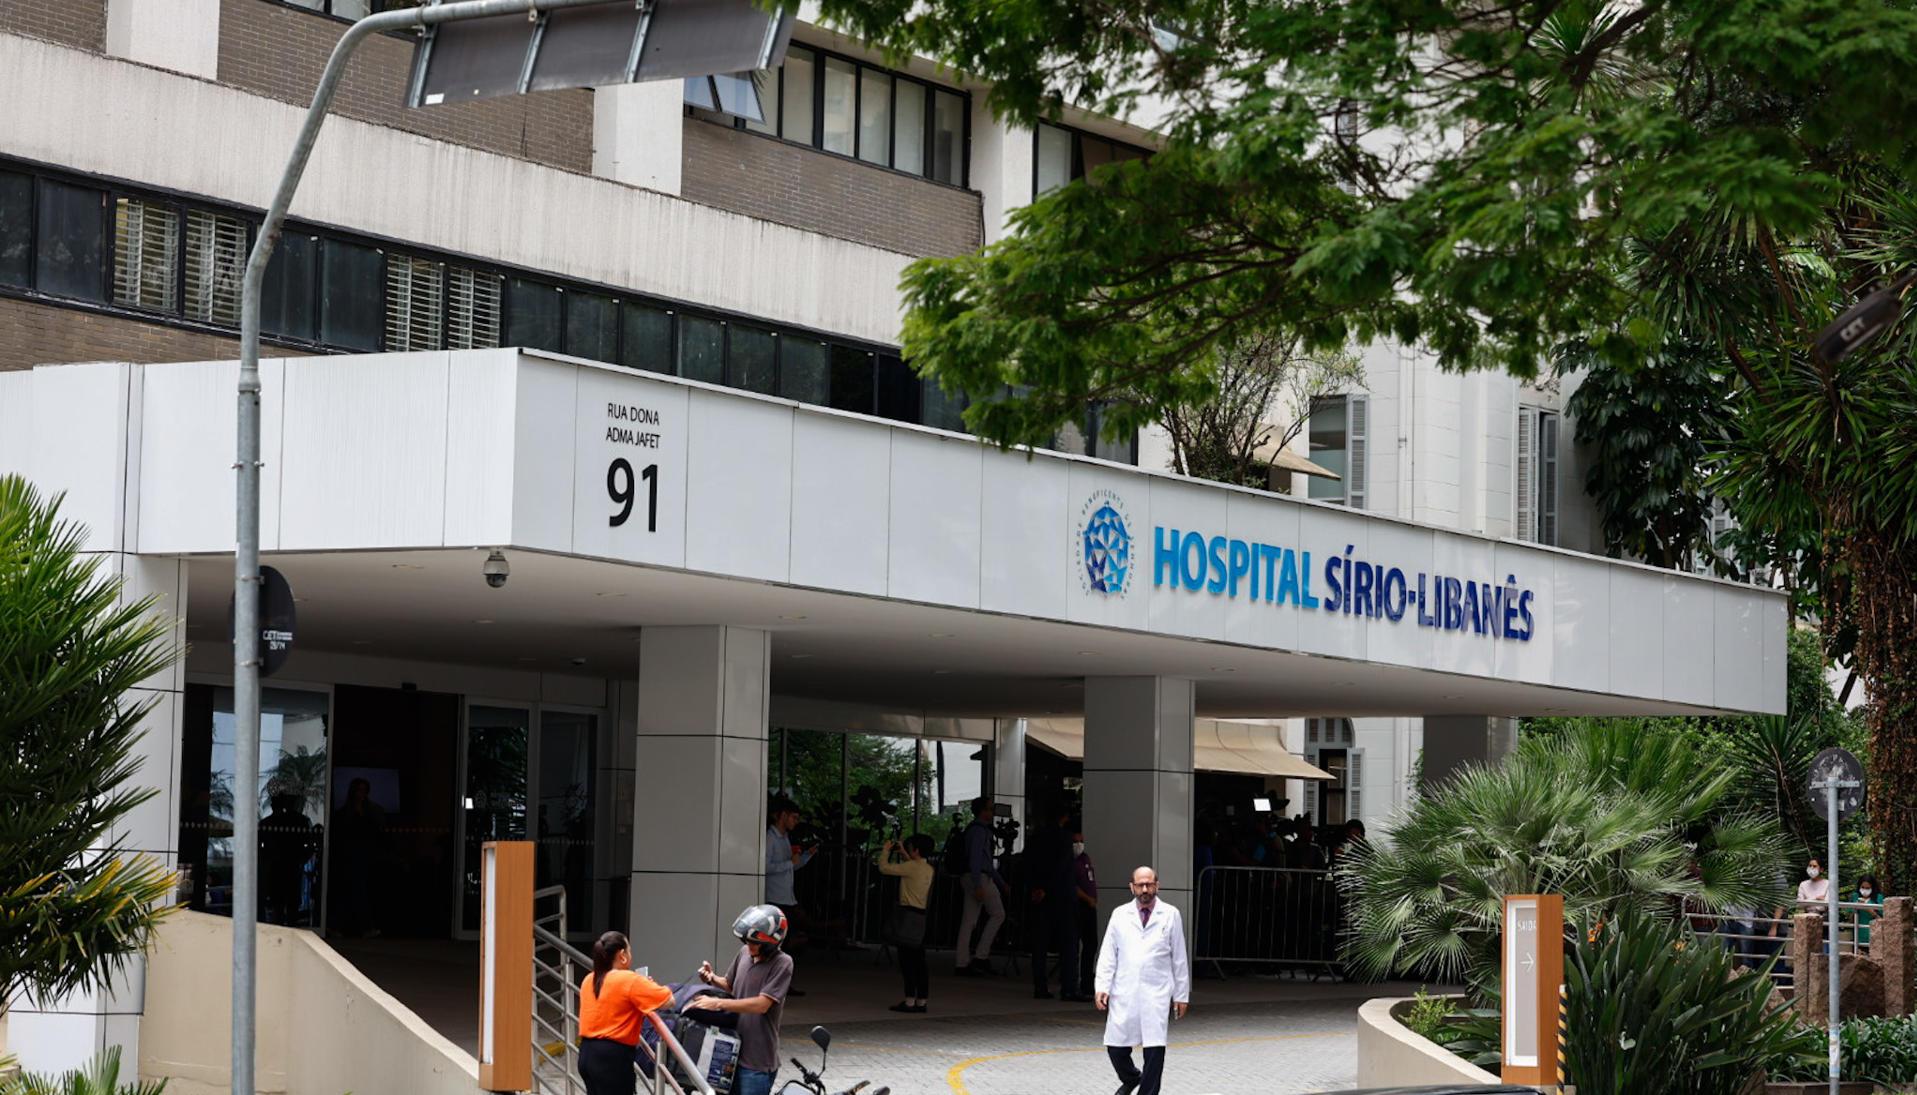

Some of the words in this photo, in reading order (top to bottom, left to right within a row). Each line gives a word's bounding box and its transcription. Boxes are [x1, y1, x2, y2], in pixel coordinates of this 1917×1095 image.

[606, 427, 634, 446] ADMA
[635, 431, 661, 449] JAFET
[608, 403, 628, 420] RUA
[630, 407, 660, 426] DONA
[607, 457, 658, 532] 91
[1153, 526, 1319, 609] HOSPITAL
[1324, 544, 1534, 642] SÍRIO-LIBANÊS
